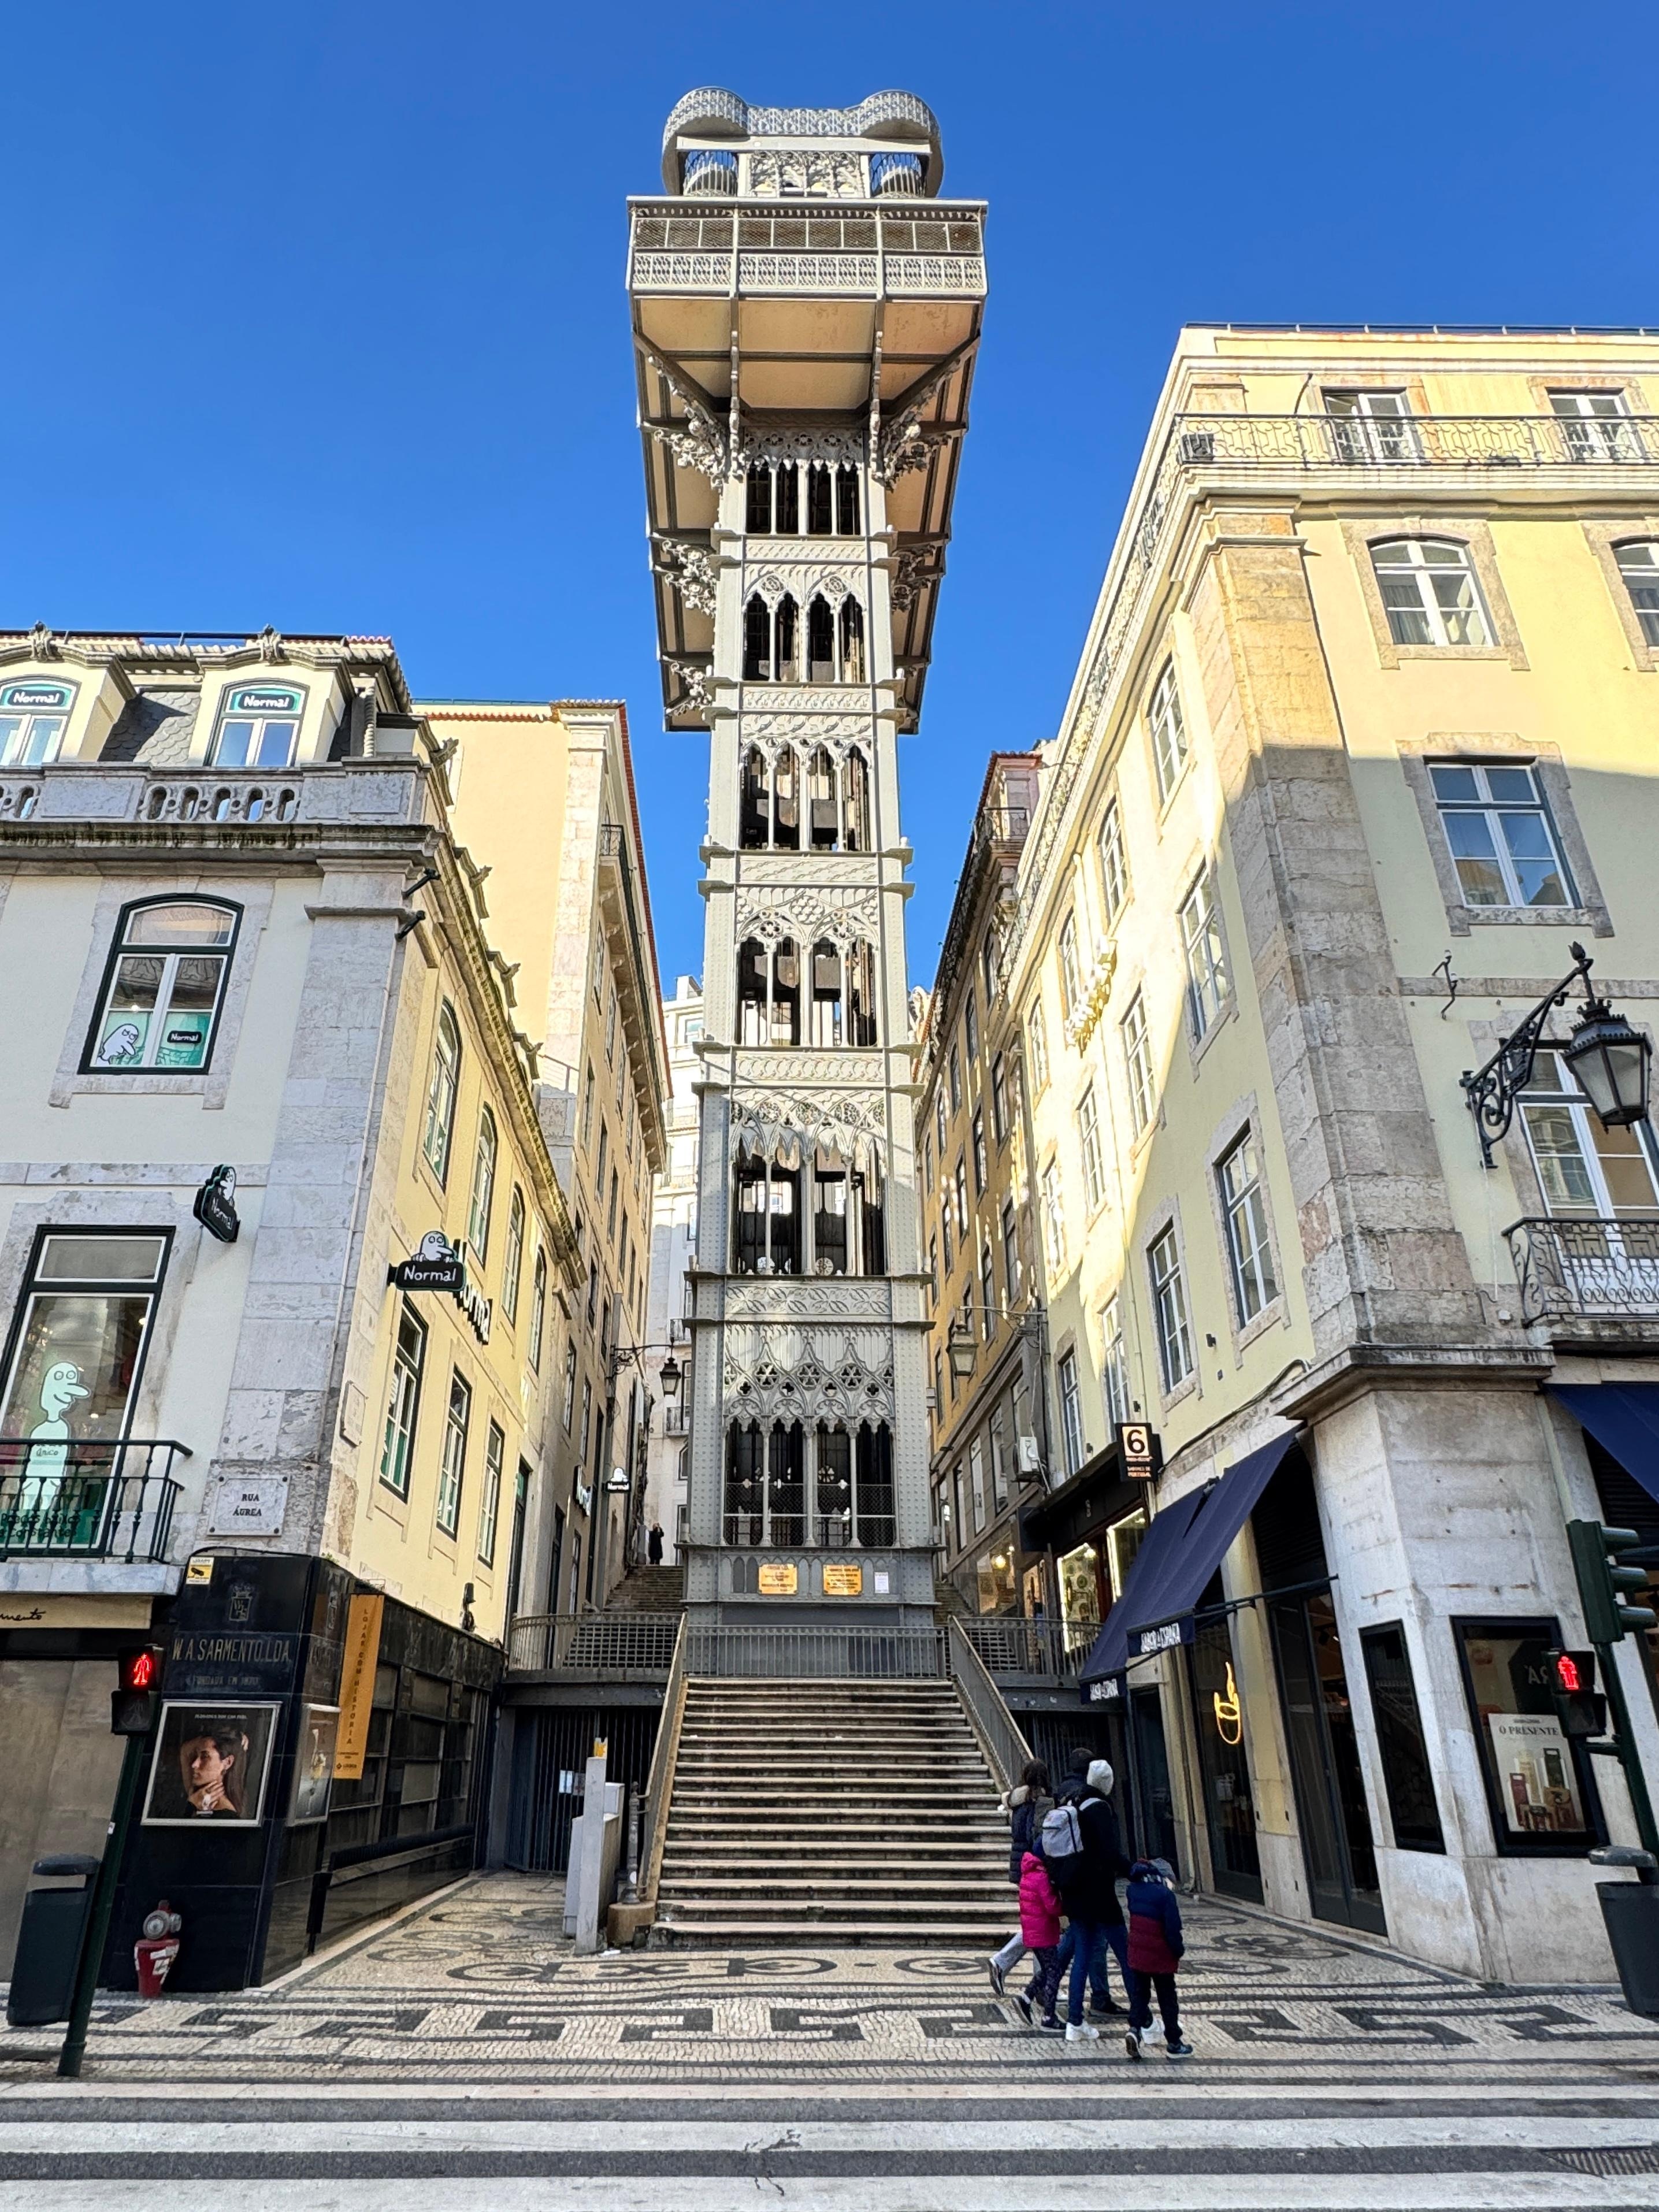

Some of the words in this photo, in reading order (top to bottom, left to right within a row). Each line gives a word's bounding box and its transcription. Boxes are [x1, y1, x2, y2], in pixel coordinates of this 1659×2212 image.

[13, 692, 60, 703] Normal
[244, 695, 290, 708] Normal
[171, 1033, 199, 1041] Normal
[211, 1197, 234, 1230] Normal
[404, 1265, 456, 1282] Normal
[1127, 1429, 1145, 1454] 6
[232, 1505, 262, 1516] ÁUREA
[1499, 1724, 1506, 1734] O
[1508, 1725, 1558, 1735] PRESENTE
